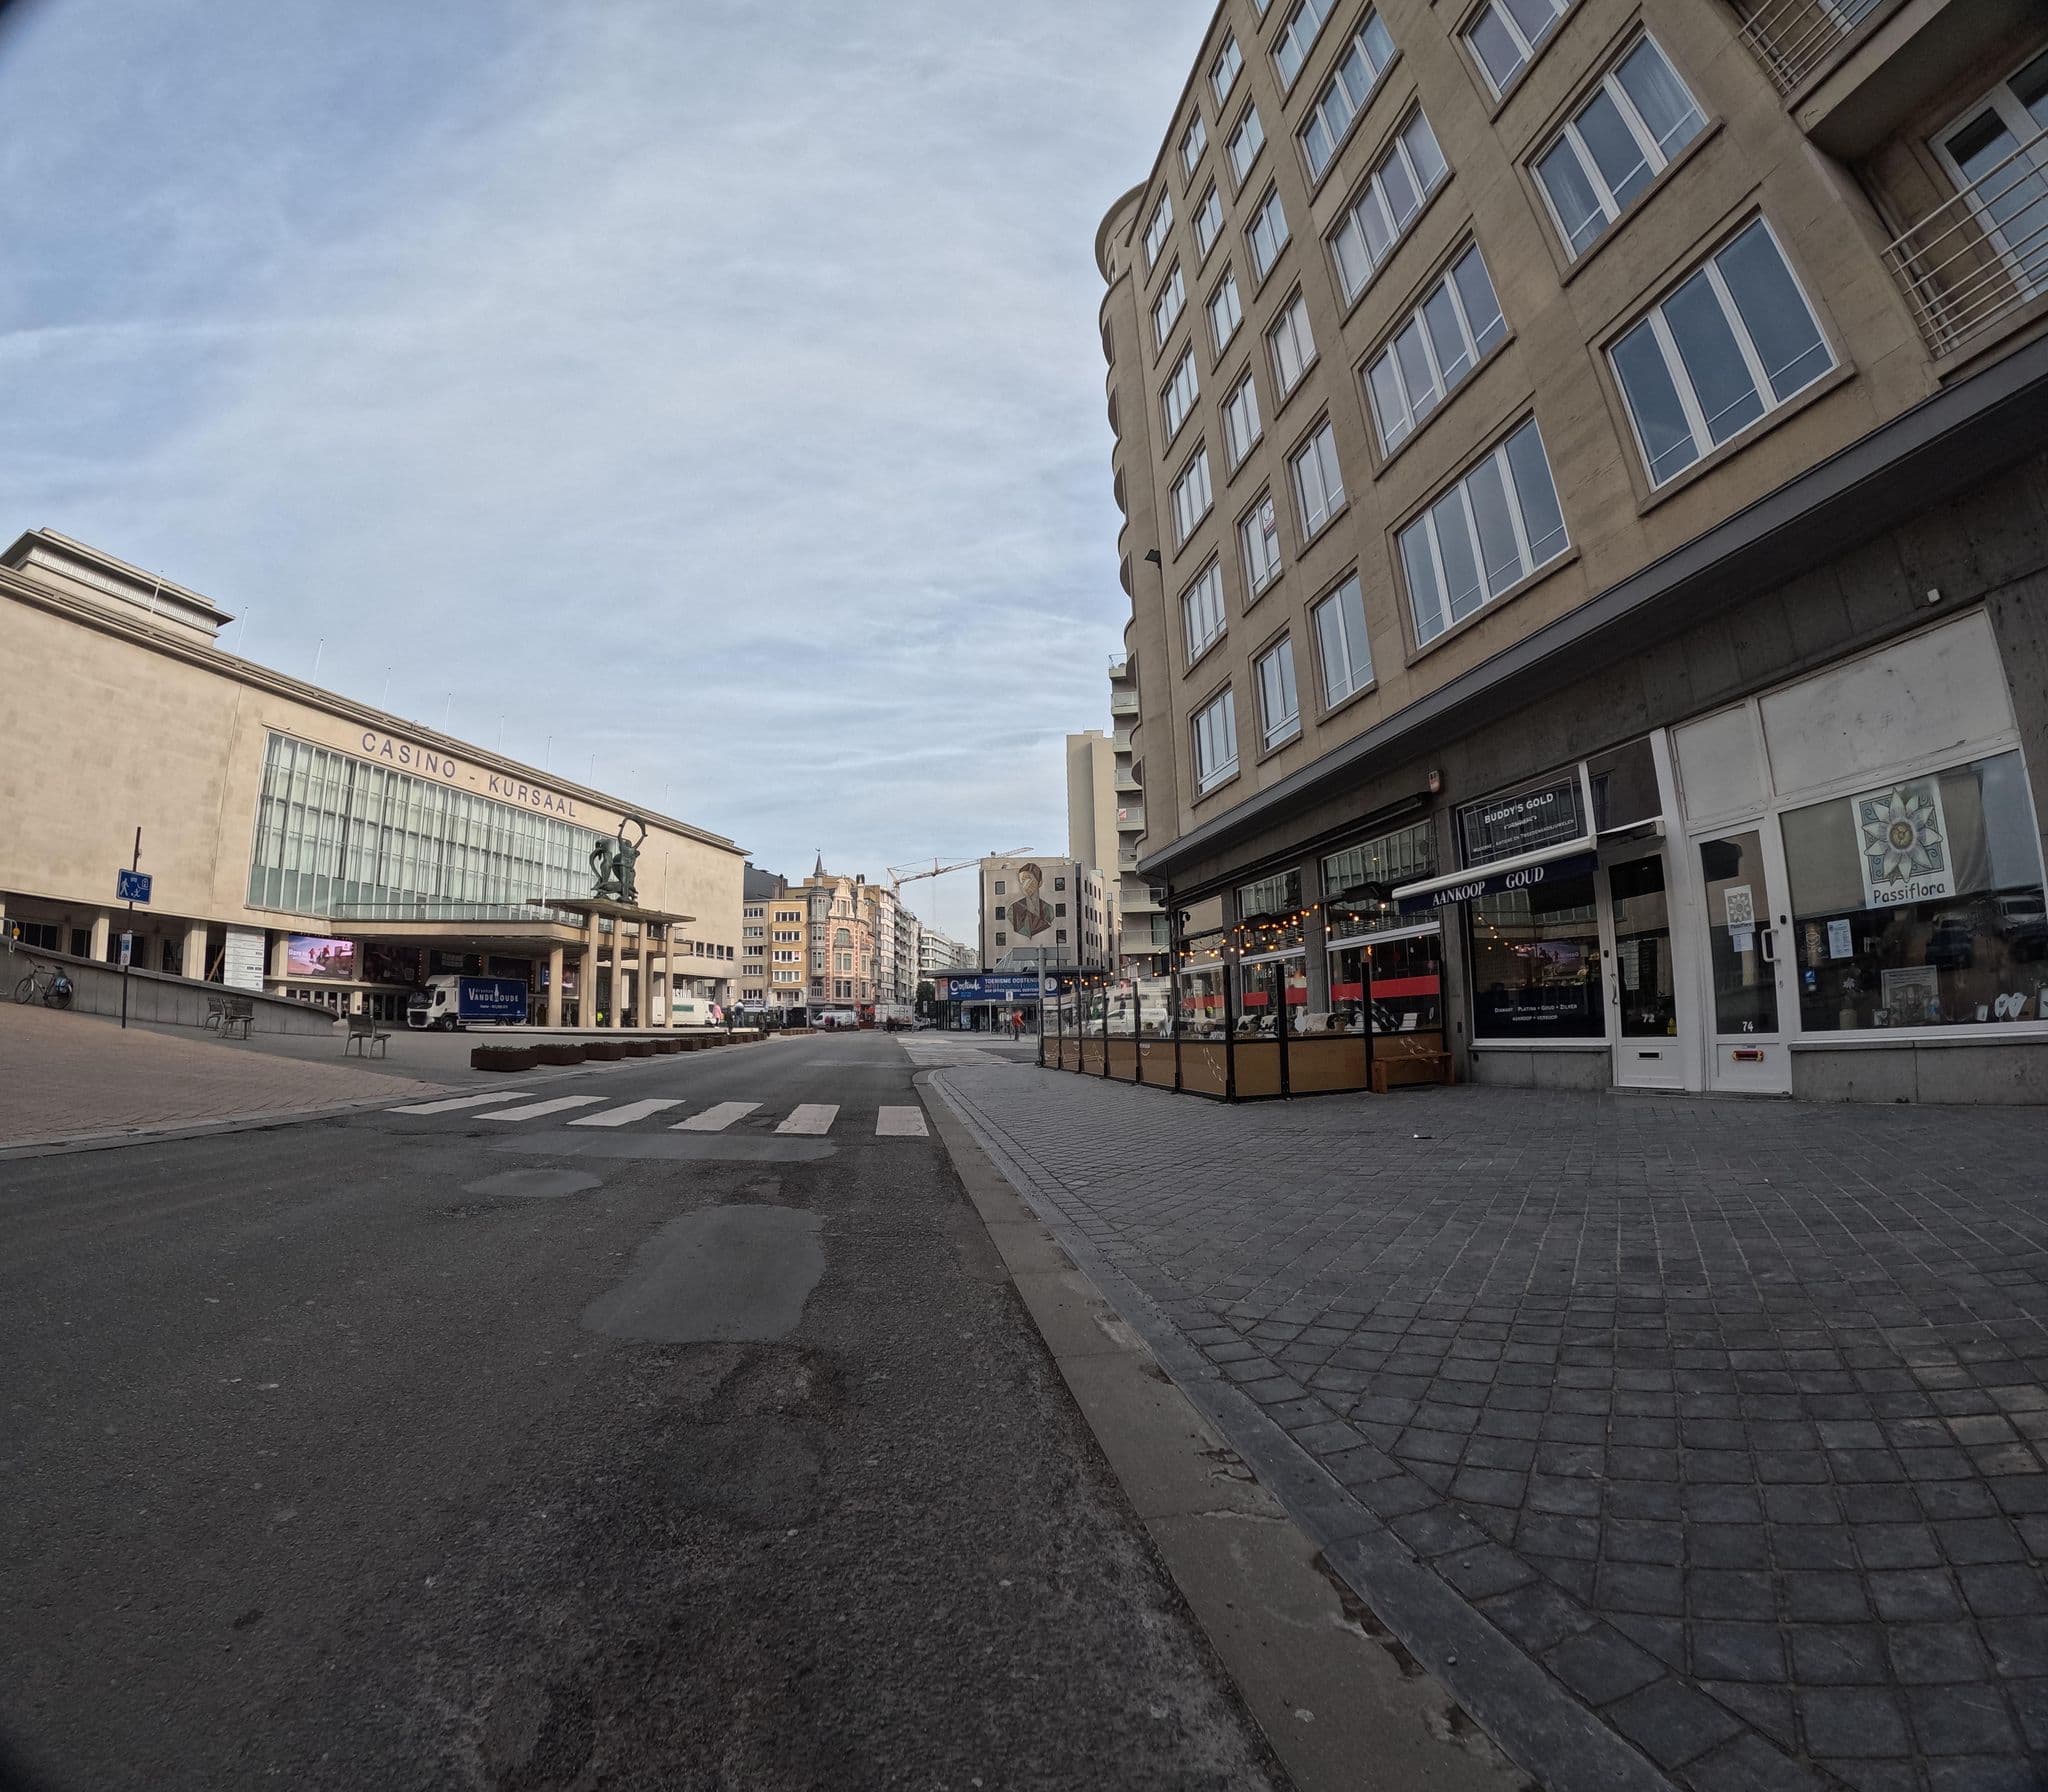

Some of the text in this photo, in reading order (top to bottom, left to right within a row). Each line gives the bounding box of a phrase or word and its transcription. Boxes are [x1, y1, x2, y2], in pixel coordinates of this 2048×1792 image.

[362, 732, 456, 778] CASINO
[489, 774, 577, 818] KURSAAL
[1484, 803, 1524, 824] BUDDY'S
[1526, 793, 1554, 809] GOLD
[1432, 866, 1544, 906] AANKOOP GOUD
[1873, 882, 1946, 904] Passiflora
[1641, 1014, 1656, 1023] 72
[1742, 1021, 1754, 1032] 74
